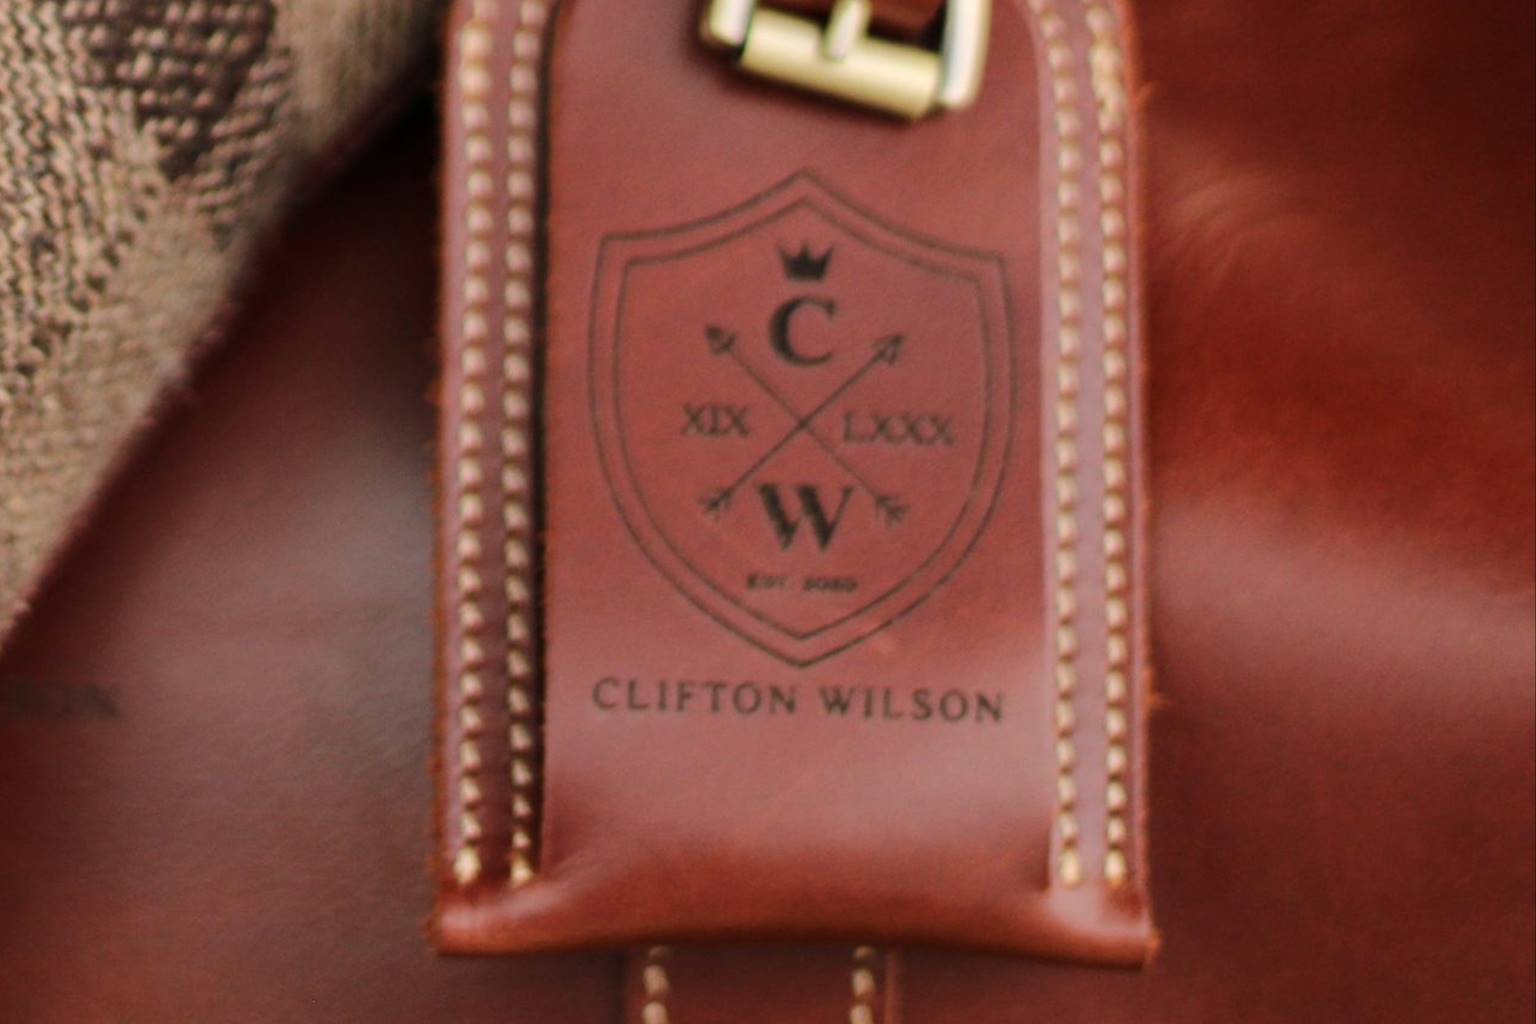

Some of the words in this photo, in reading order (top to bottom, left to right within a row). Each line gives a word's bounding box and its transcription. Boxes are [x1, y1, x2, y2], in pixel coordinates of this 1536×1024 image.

[769, 295, 837, 367] C
[681, 403, 751, 439] XIX
[842, 410, 956, 446] LXXX
[759, 483, 855, 553] W
[592, 676, 797, 716] CLIFTON
[820, 684, 1004, 723] WILSON
